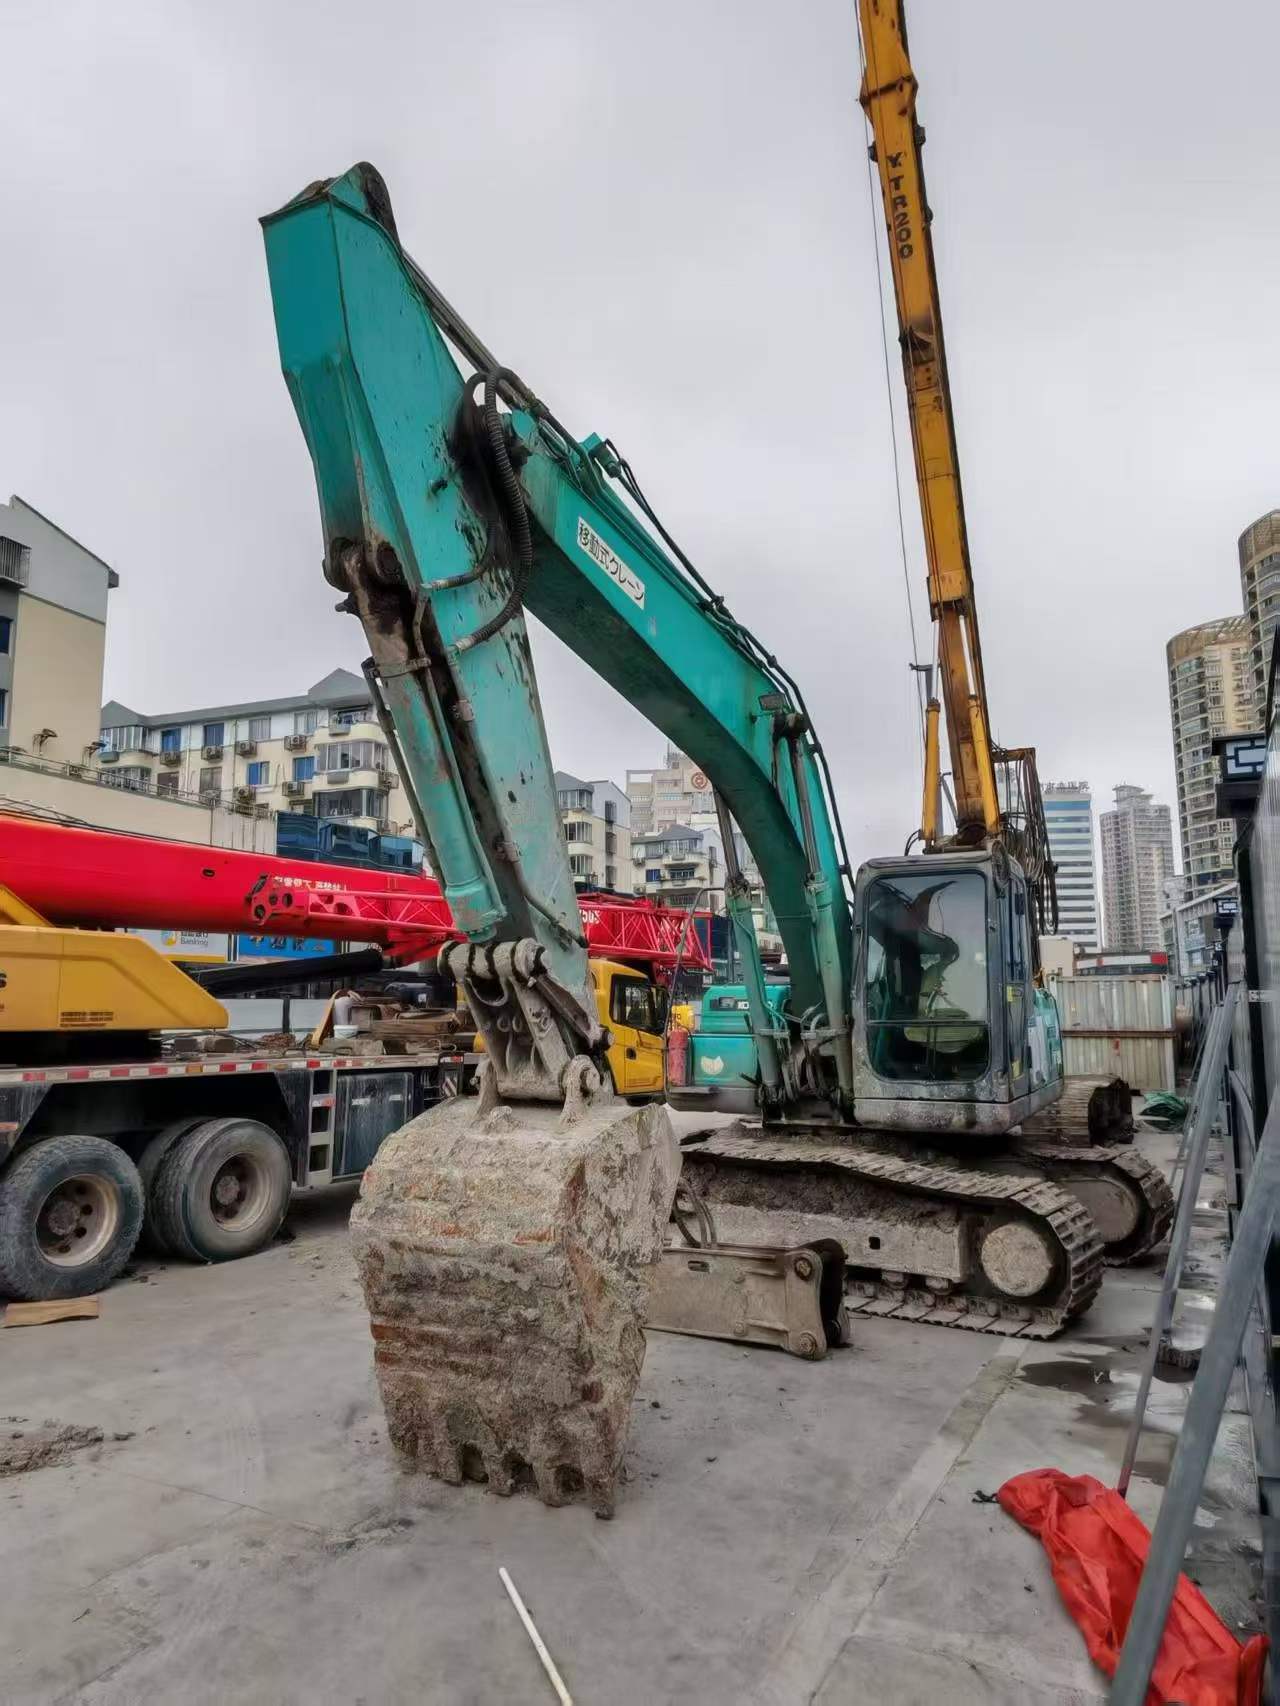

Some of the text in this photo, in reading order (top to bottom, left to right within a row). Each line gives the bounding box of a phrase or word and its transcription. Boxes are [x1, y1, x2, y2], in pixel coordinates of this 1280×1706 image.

[580, 523, 643, 600] 移動式クレーン
